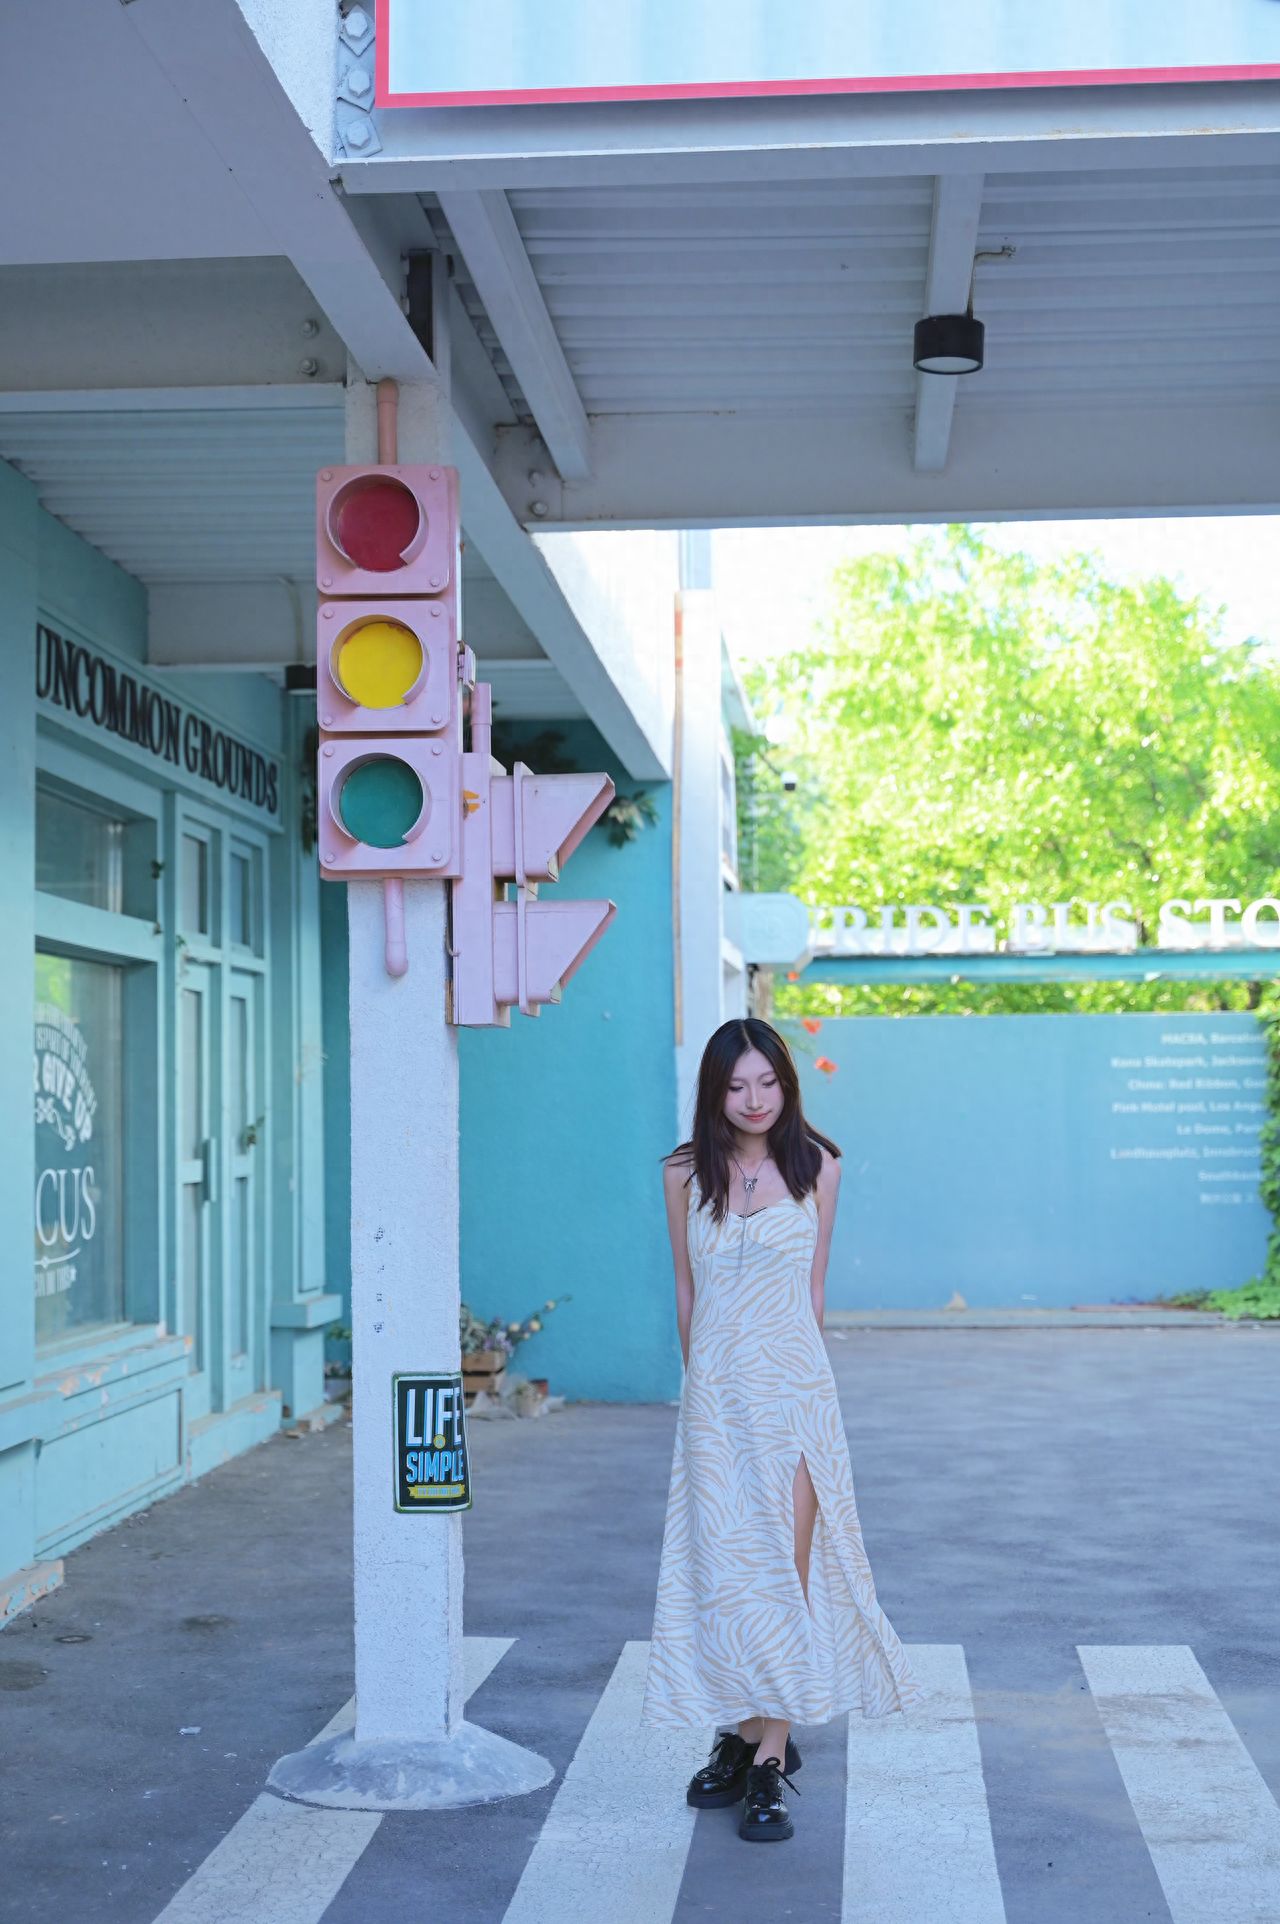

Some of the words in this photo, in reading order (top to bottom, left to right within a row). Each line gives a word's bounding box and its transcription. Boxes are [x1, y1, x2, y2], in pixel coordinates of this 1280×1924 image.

[36, 622, 182, 766] UNCOMMON
[183, 713, 278, 815] GROUNDS
[1009, 901, 1136, 952] BUS
[406, 1387, 462, 1446] LIFE
[406, 1450, 464, 1483] SIMPLE
